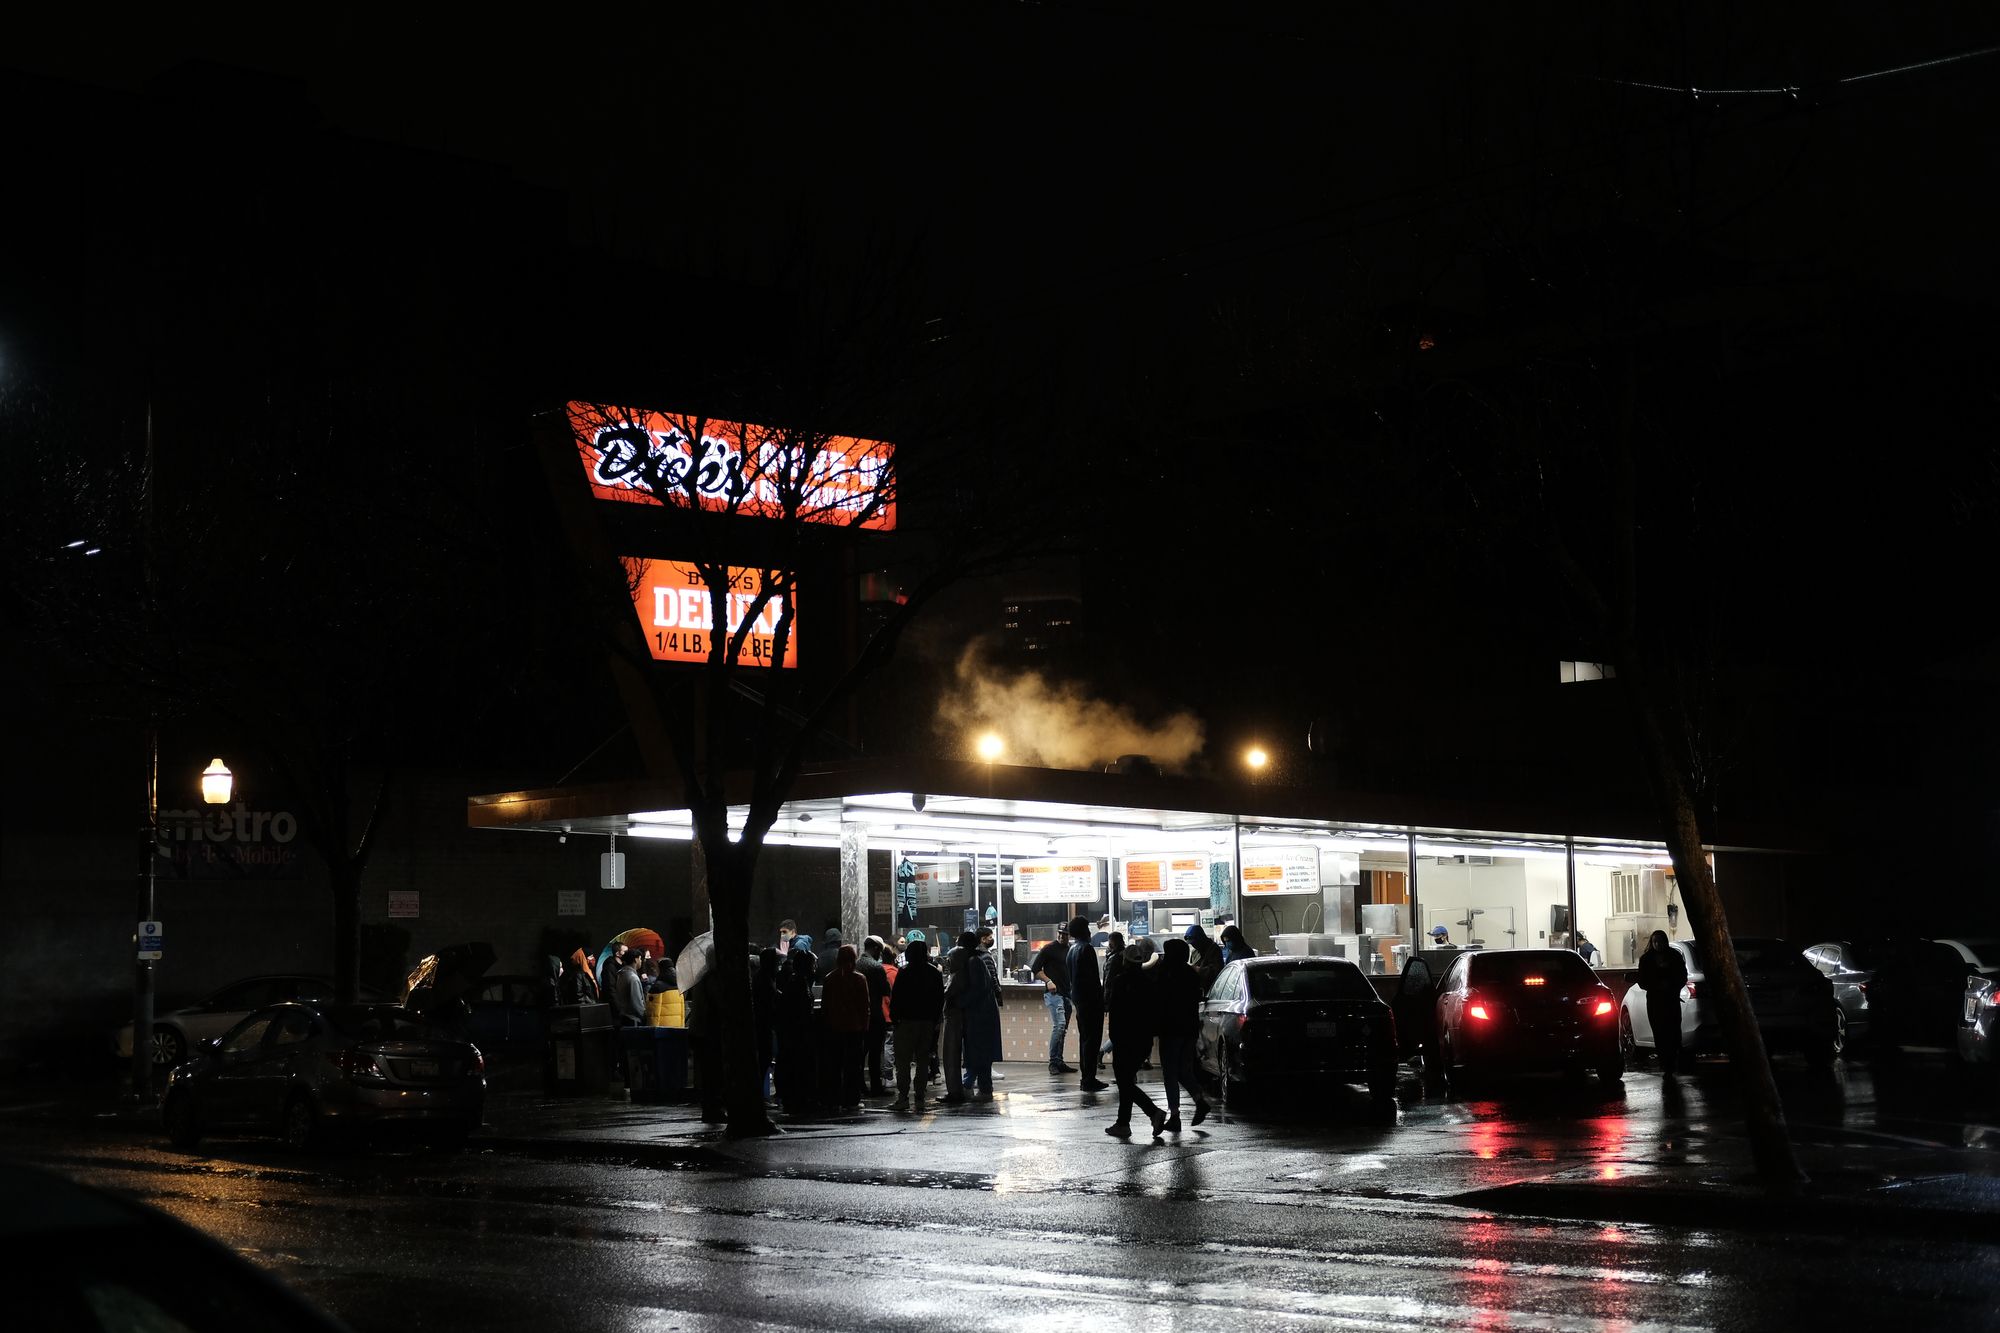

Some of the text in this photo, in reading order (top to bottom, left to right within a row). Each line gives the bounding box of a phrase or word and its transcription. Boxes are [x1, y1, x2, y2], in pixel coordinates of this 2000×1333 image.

[656, 632, 678, 653] 1/4
[683, 633, 706, 654] LB.
[753, 638, 789, 658] BE
[159, 802, 297, 843] metro
